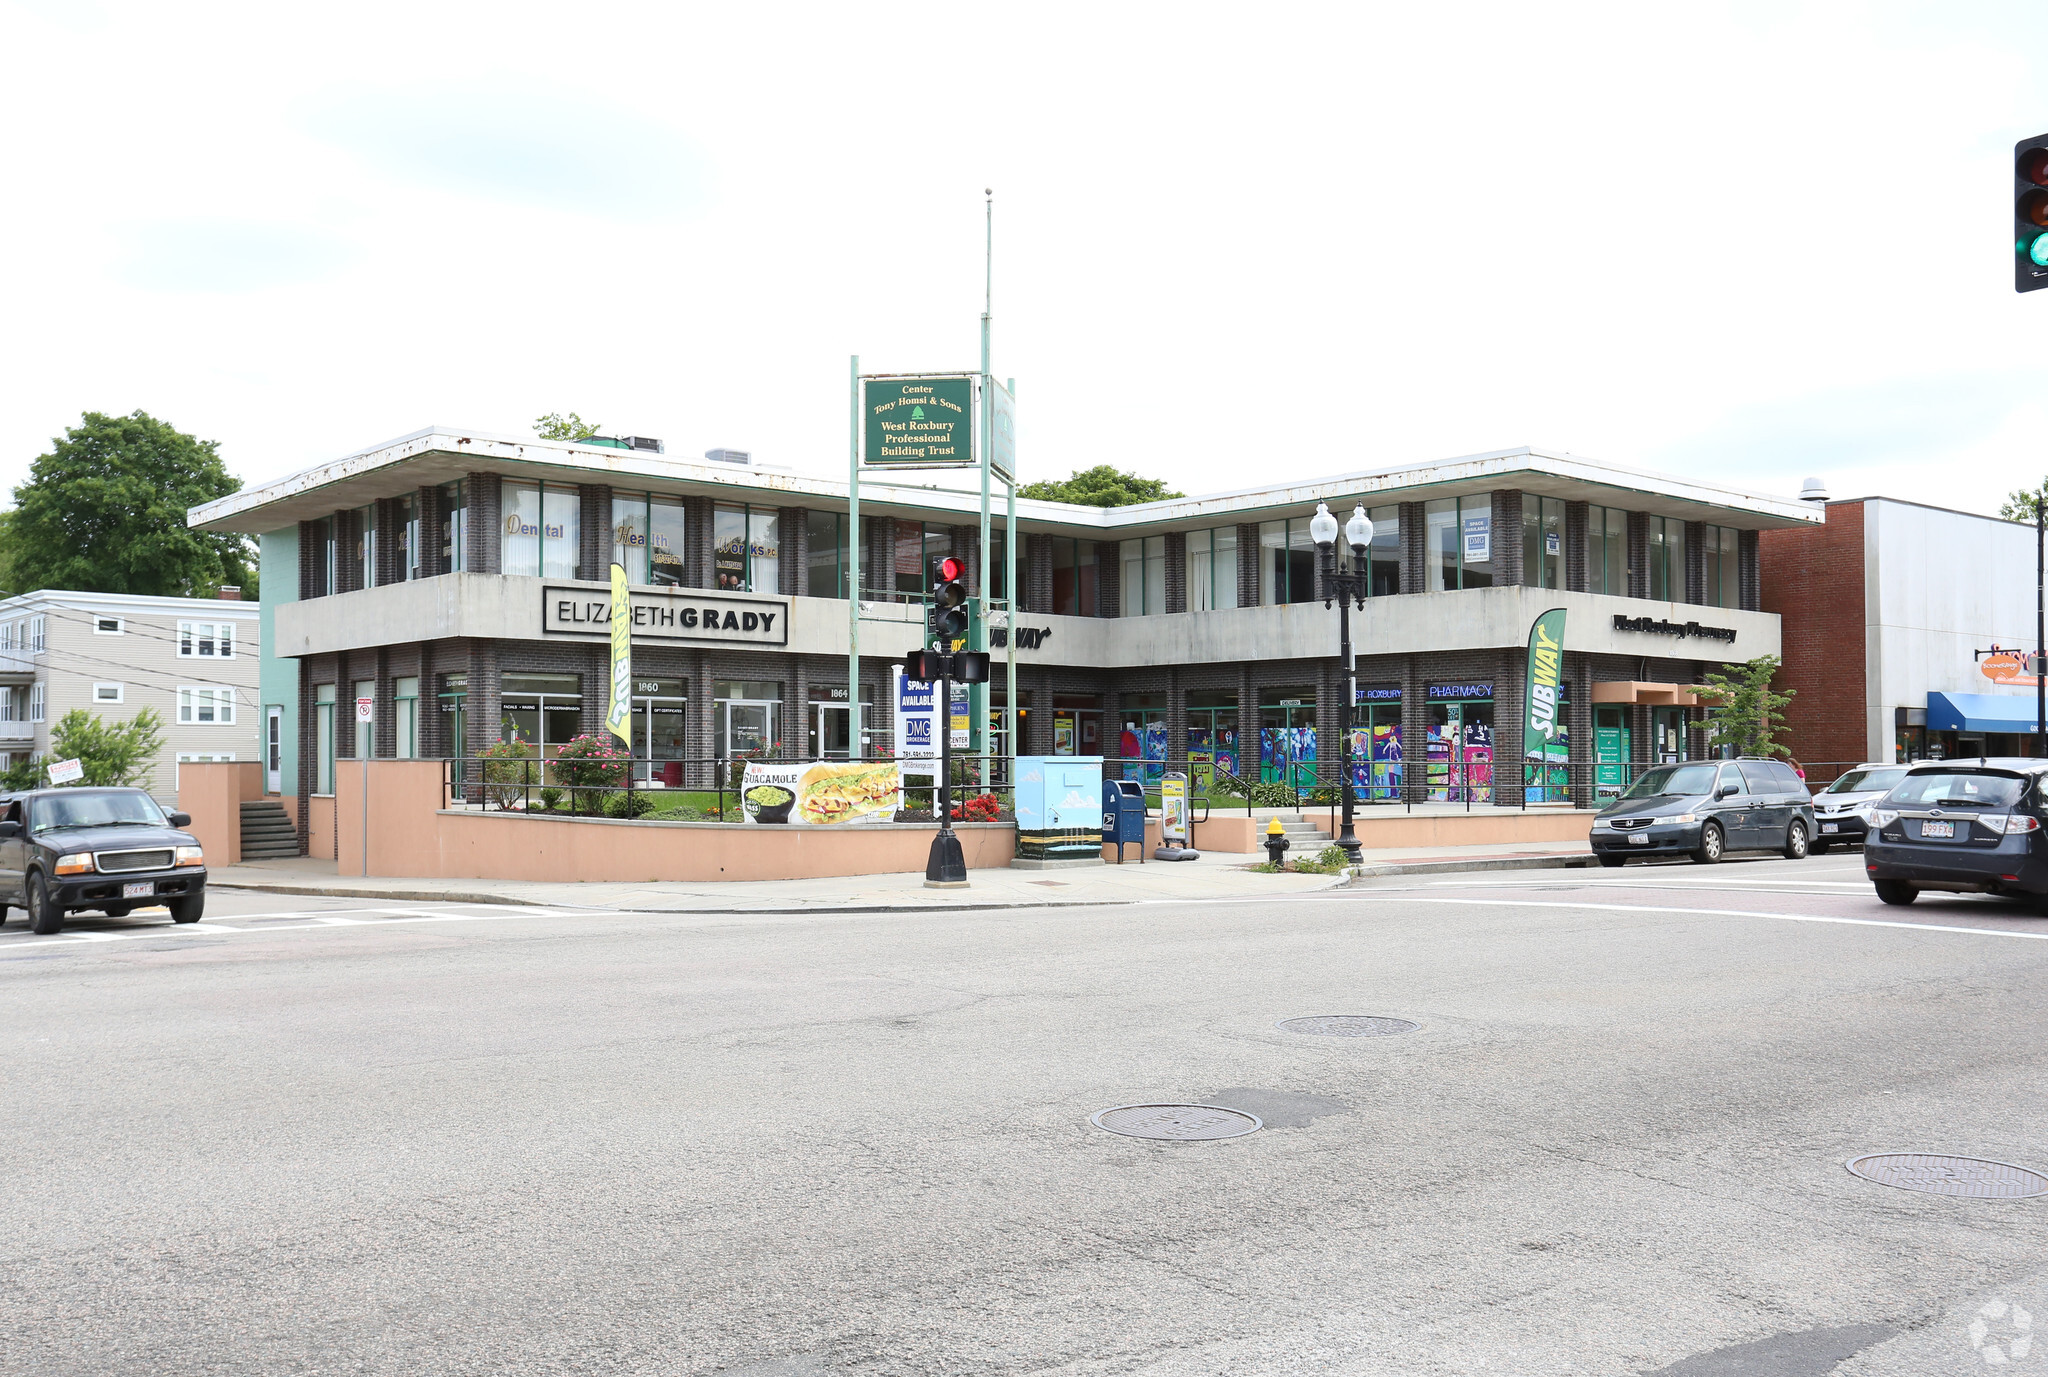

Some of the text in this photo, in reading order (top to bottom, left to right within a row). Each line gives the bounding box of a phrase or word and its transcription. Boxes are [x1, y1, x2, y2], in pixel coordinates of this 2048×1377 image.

[902, 385, 934, 394] Center
[873, 396, 962, 415] Tony Homsi & Sons
[881, 420, 955, 431] West Roxbury
[885, 433, 951, 444] Professional
[881, 446, 955, 457] Building Trust
[507, 514, 564, 538] Dental
[615, 525, 668, 548] Health
[1469, 537, 1484, 545] DMG
[716, 535, 765, 556] Works
[679, 607, 777, 632] GRADY
[1613, 614, 1737, 644] West Roxbury Pharmacy
[990, 627, 1052, 650] UBWAY
[638, 682, 659, 692] 1860
[907, 680, 930, 691] SPACE
[1531, 623, 1559, 741] SUBWAY
[831, 689, 848, 698] 1864
[1367, 689, 1402, 699] ROXBURY
[1429, 684, 1493, 698] PHARMACY
[902, 695, 935, 706] AVAILABLE
[906, 720, 931, 736] DMG
[743, 772, 798, 784] GUACAMOLE
[1923, 824, 1937, 834] 199
